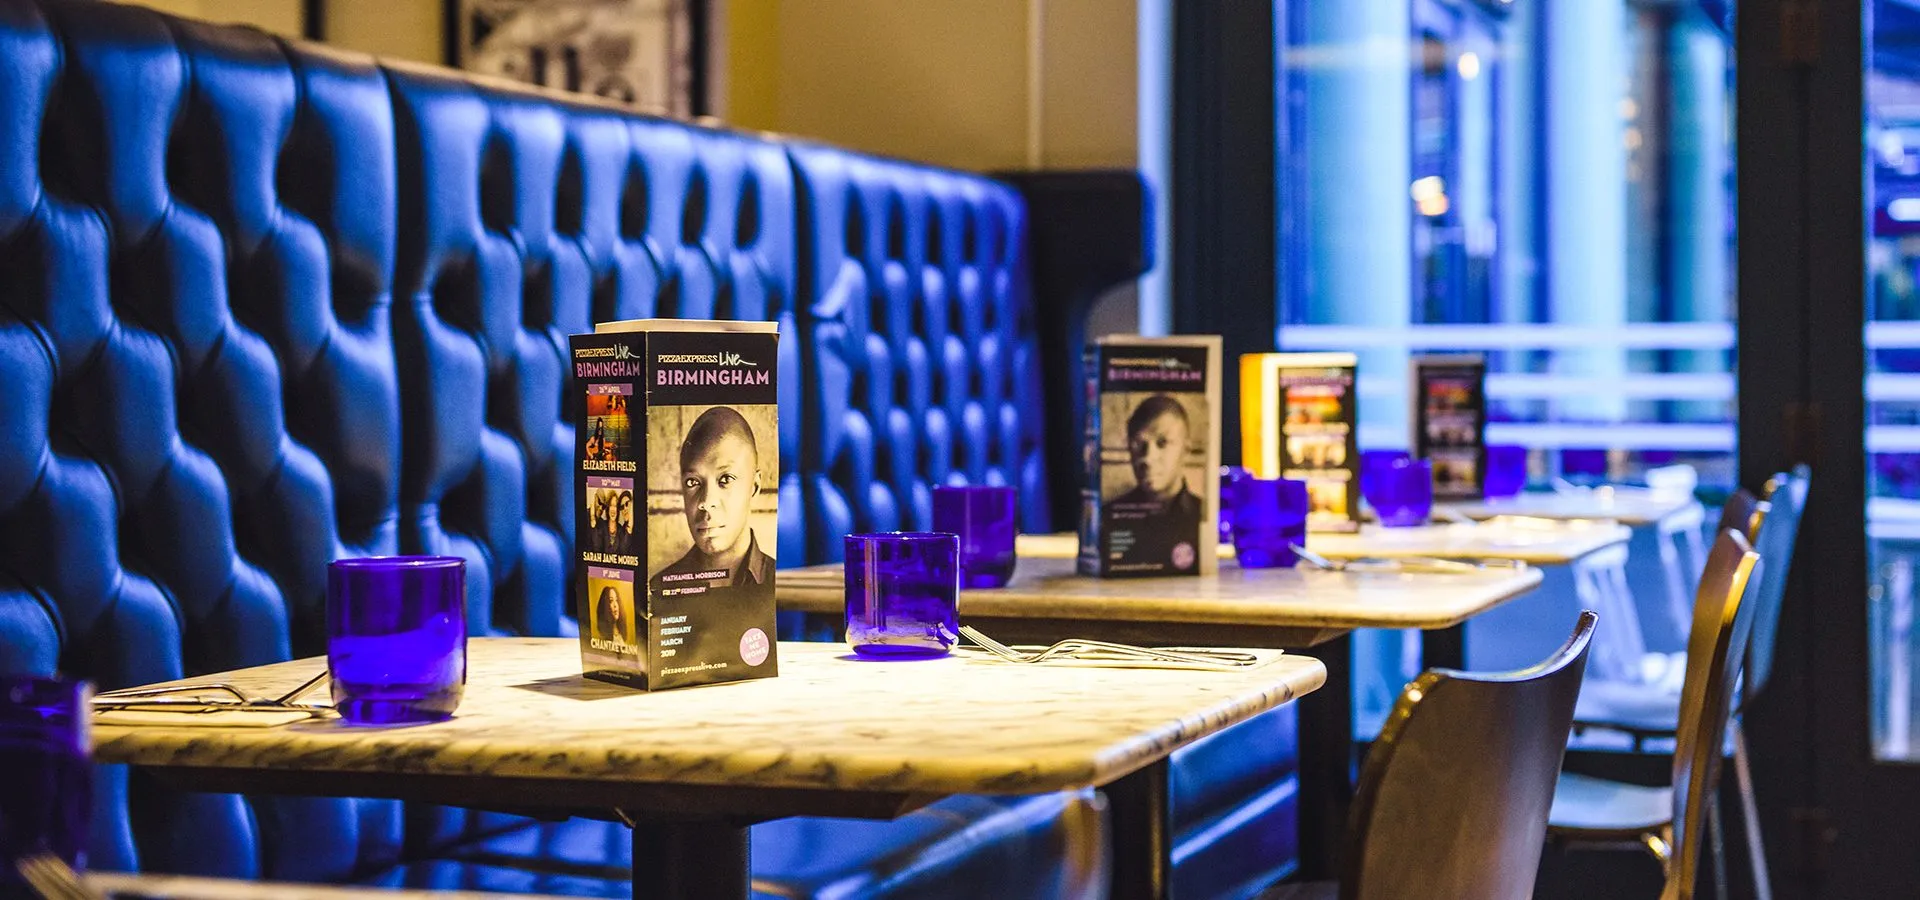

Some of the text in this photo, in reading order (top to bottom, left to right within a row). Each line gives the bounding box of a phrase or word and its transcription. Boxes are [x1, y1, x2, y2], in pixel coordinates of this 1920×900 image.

[719, 351, 757, 366] Live
[576, 361, 640, 378] BIRMINGHAM
[657, 369, 769, 385] BIRMINGHAM
[583, 460, 637, 472] ELIZABETH FIELDS
[583, 551, 639, 567] SARAH JANE MORRIS
[662, 571, 727, 582] NATHANIEL MORRISON
[660, 615, 687, 625] JANUARY
[660, 625, 692, 636] FEBRUARY
[660, 638, 683, 647] MARCH
[660, 649, 676, 658] 2019
[660, 661, 728, 677] pizzaexpresslive.com
